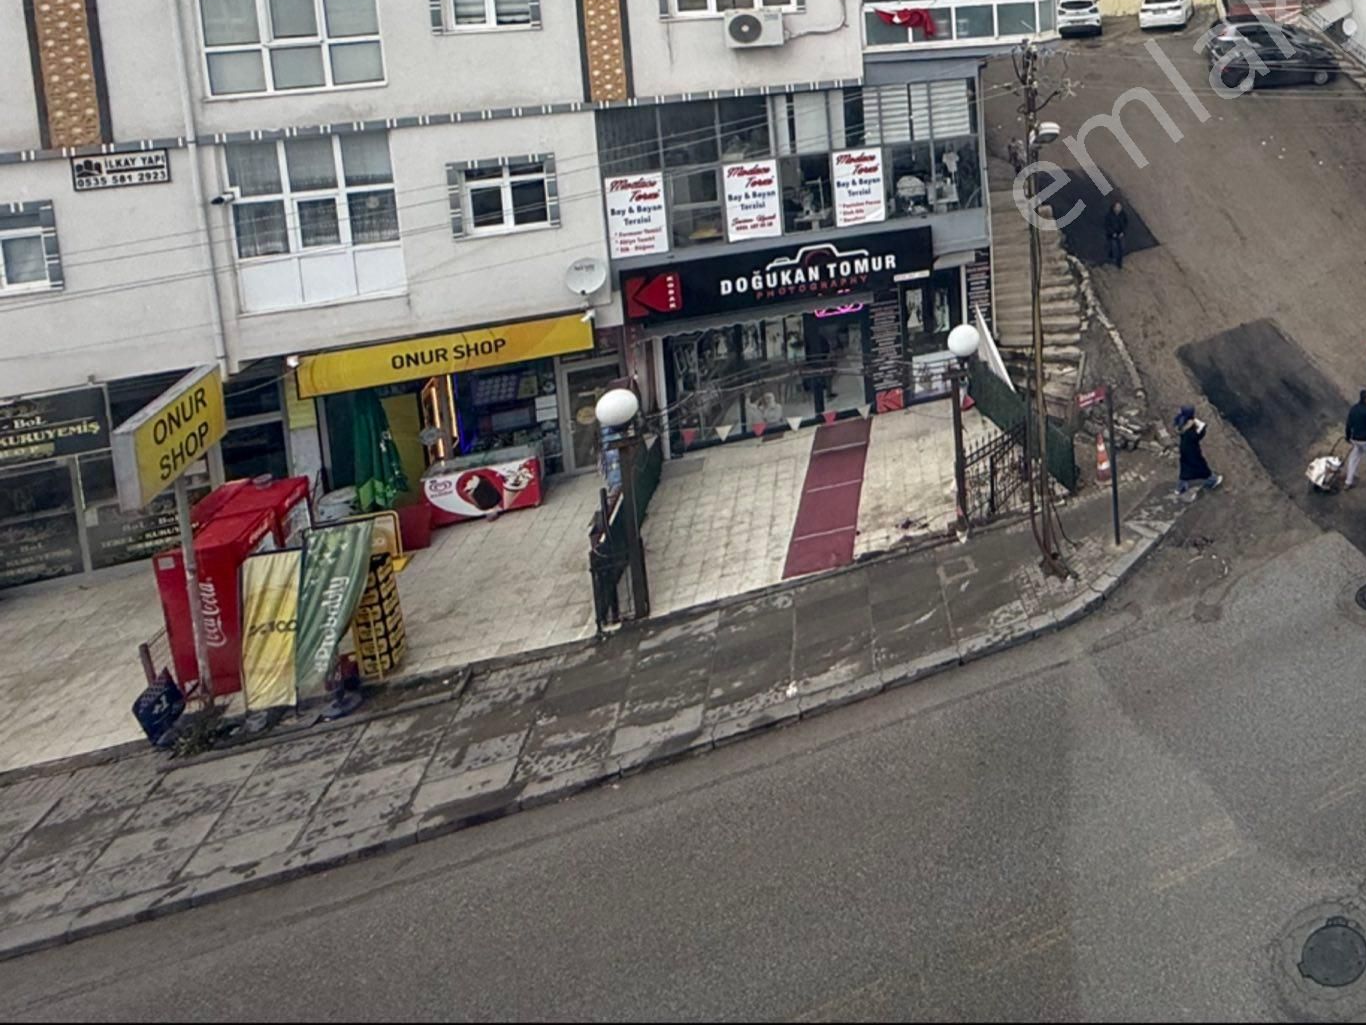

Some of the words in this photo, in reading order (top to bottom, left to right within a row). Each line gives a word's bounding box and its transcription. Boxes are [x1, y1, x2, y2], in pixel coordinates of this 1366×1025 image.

[141, 155, 165, 166] YAPI
[752, 190, 776, 199] Bayan
[836, 180, 849, 188] Bay
[859, 177, 881, 185] Bayan
[610, 208, 626, 216] Bay
[637, 204, 662, 213] Bayan
[720, 265, 819, 295] DOĞUKAN
[827, 254, 896, 278] TOMUR
[756, 274, 869, 300] PHOTOGRAPHY
[391, 347, 448, 370] ONUR
[453, 338, 506, 360] SHOP
[153, 387, 208, 445] ONUR
[160, 422, 209, 480] SHOP
